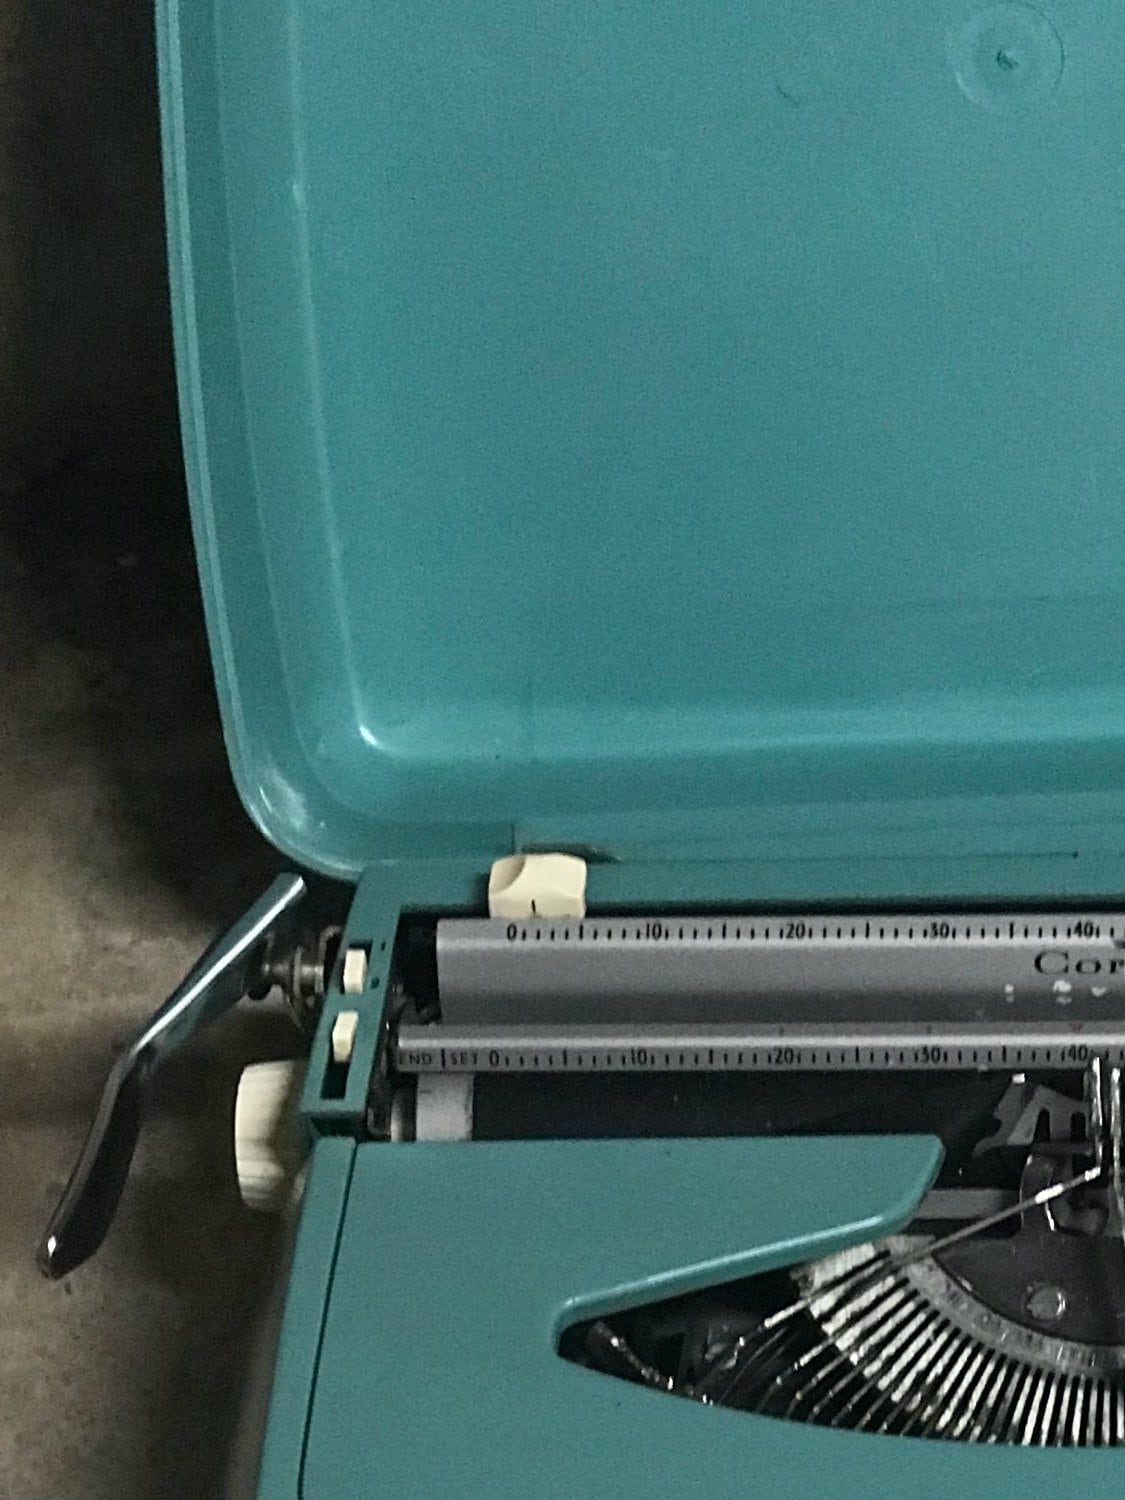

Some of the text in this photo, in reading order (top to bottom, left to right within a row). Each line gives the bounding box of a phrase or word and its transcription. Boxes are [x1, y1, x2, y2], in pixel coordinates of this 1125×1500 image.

[507, 923, 518, 941] 0
[645, 922, 663, 941] 10
[785, 922, 806, 940] 20
[930, 922, 950, 939] 30
[1073, 920, 1095, 938] 40
[451, 1051, 478, 1065] SET
[773, 1048, 795, 1066] 20
[920, 1047, 941, 1064] 30
[1068, 1044, 1089, 1062] 40
